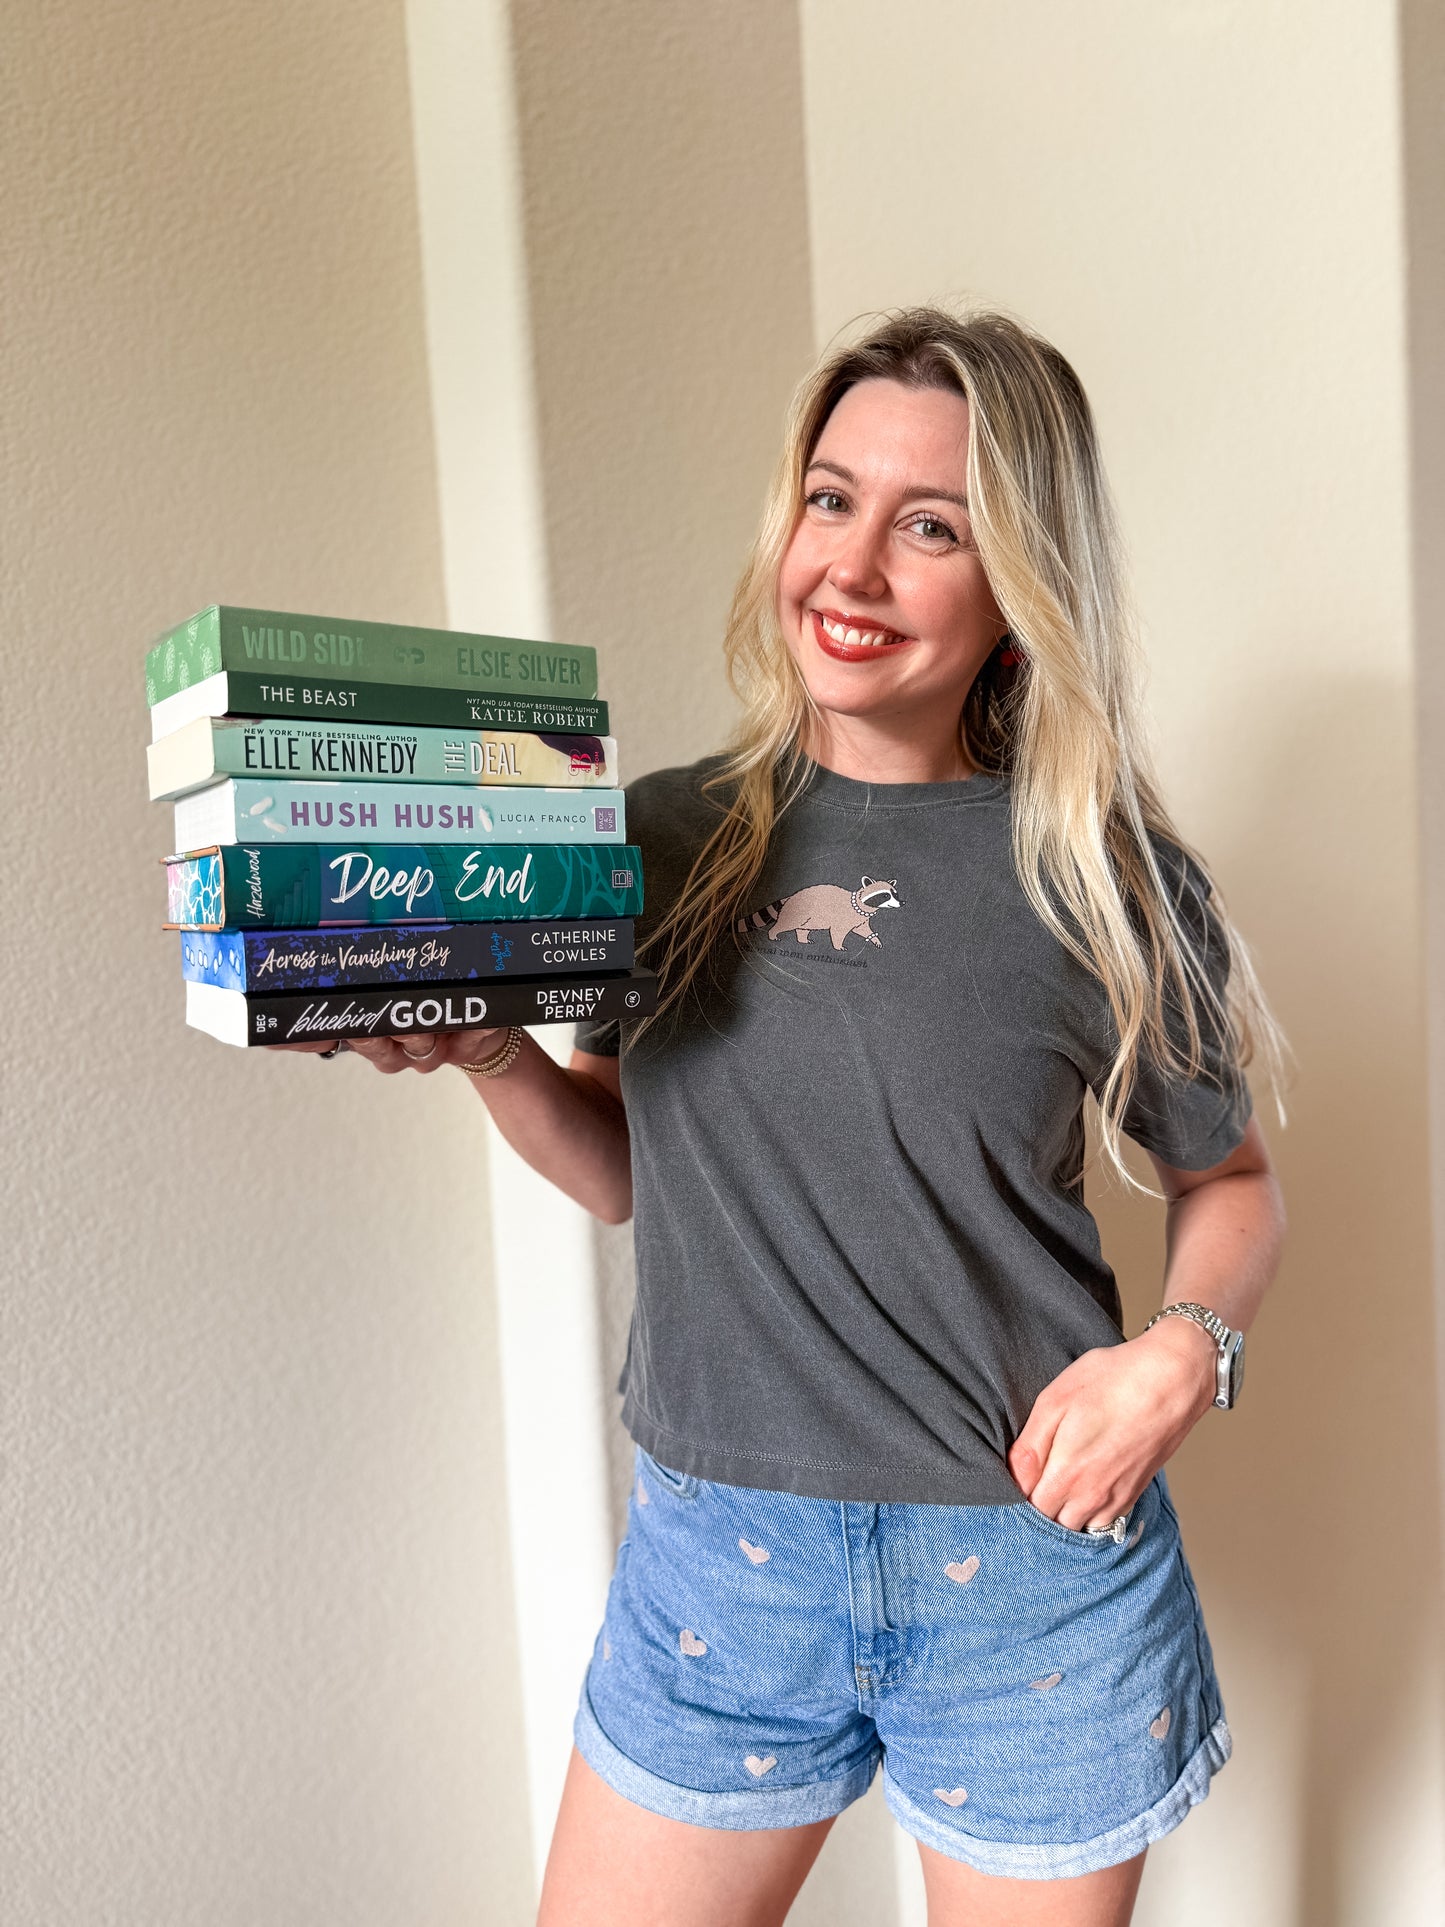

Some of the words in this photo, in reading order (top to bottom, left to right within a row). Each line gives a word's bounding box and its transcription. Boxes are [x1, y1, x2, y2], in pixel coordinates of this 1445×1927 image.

[242, 626, 306, 662] WILD
[457, 647, 512, 679] ELSIE
[518, 654, 582, 685] SILVER
[260, 685, 295, 703] THE
[303, 688, 358, 708] BEAST
[482, 699, 496, 707] AND
[513, 701, 534, 709] TODAY
[535, 703, 573, 713] BESTSELLING
[575, 706, 599, 714] AUTHOR
[471, 706, 527, 723] KATEE
[533, 711, 597, 728] ROBERT
[297, 730, 322, 738] TIMES
[326, 732, 381, 741] BESTSELLING
[385, 735, 418, 743] AUTHOR
[244, 735, 301, 770] ELLE
[311, 738, 418, 775] KENNEDY
[443, 740, 465, 774] THE
[470, 741, 522, 776] DEAL
[290, 801, 377, 828] HUSH
[394, 803, 474, 829] HUSH
[500, 814, 535, 823] LUCIA
[541, 814, 587, 824] FRANCO
[243, 848, 265, 919] Hazelwood
[329, 851, 434, 913] Deep
[455, 851, 536, 903] End
[531, 929, 617, 946] CATHERINE
[256, 947, 319, 977] Across
[321, 952, 336, 965] the
[338, 942, 418, 970] Vanishing
[419, 940, 451, 967] Sky
[543, 948, 607, 964] COWLES
[537, 987, 605, 1005] DEVNEY
[268, 1017, 278, 1028] 30
[286, 999, 393, 1039] bluebird
[390, 997, 487, 1028] GOLD
[545, 1003, 596, 1020] PERRY
[256, 1014, 266, 1033] DEC
